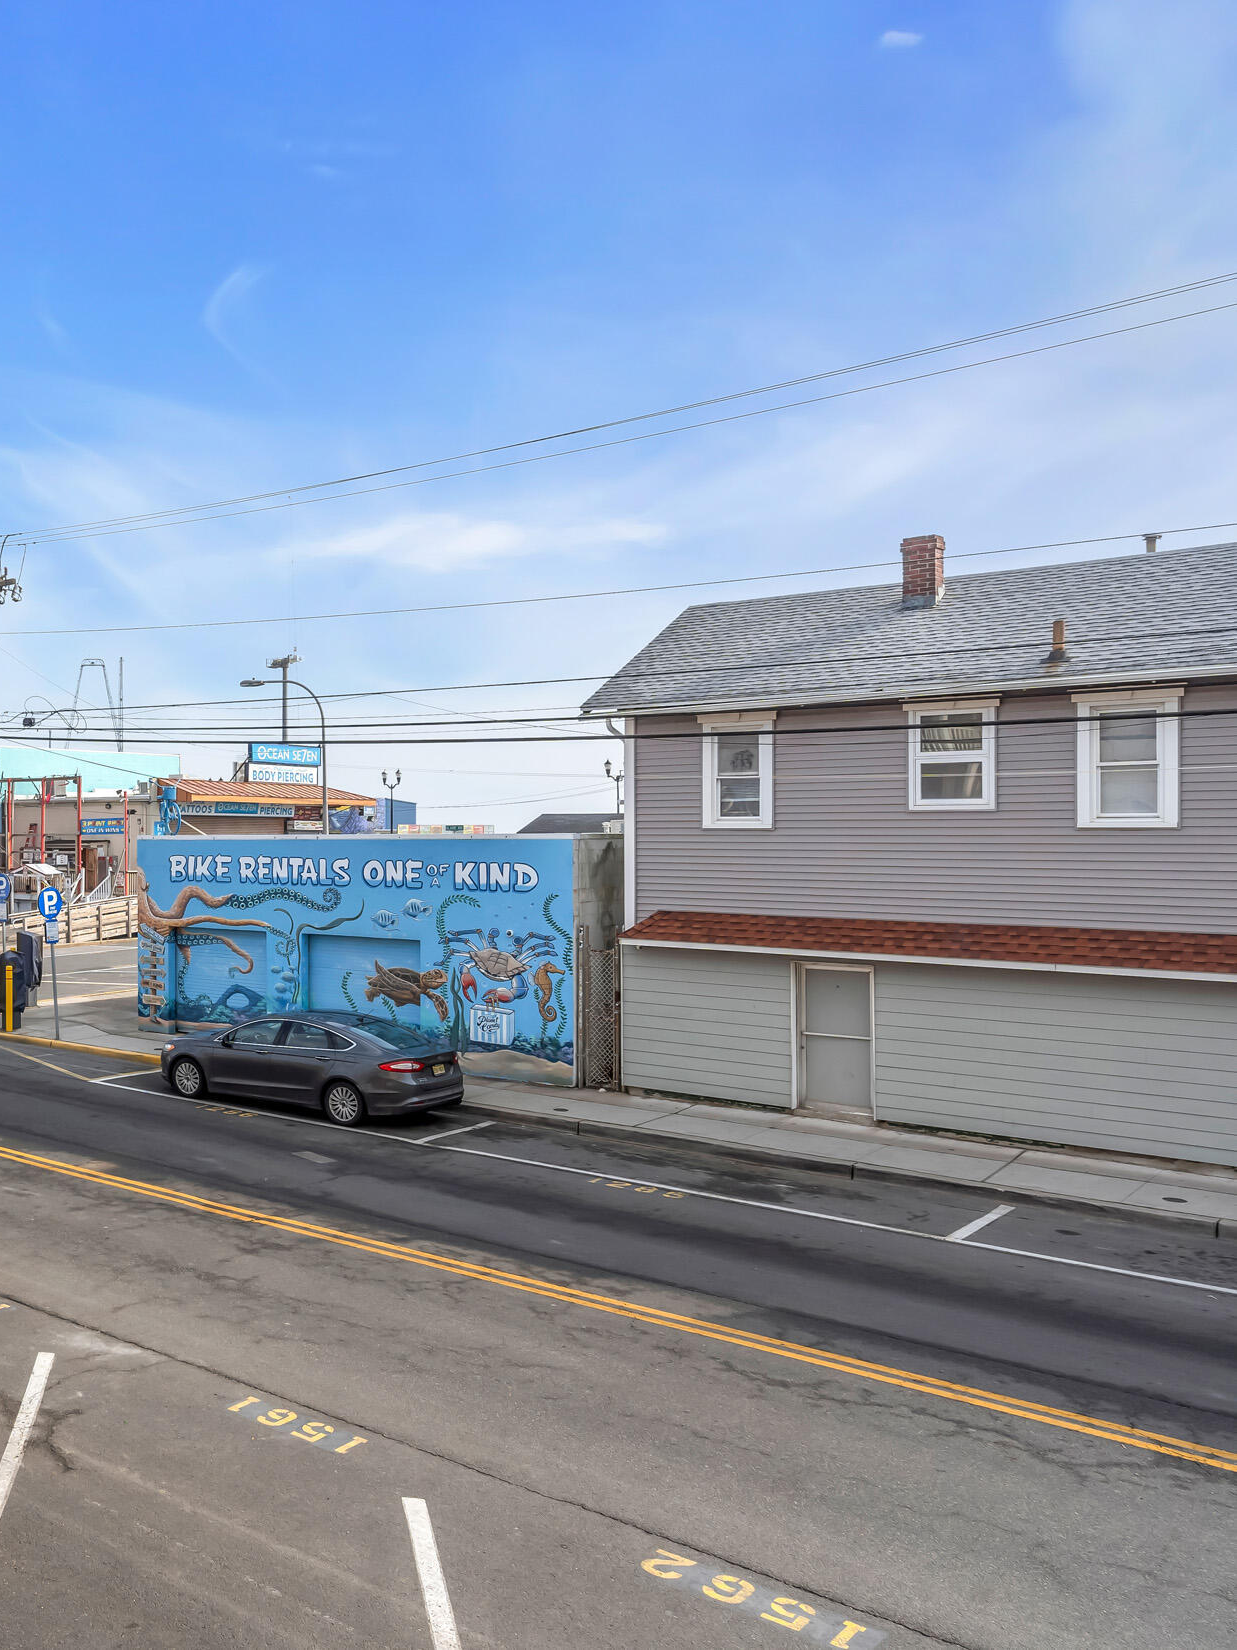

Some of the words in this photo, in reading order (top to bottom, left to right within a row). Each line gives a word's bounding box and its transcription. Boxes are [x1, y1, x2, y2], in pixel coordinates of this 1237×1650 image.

[257, 745, 290, 761] OCEAN
[252, 769, 277, 781] BODY
[277, 771, 314, 783] PIERCING
[259, 806, 293, 815] PIERCING
[169, 854, 233, 883] BIKE
[238, 855, 352, 887] RENTALS
[363, 859, 424, 889] ONE
[426, 864, 450, 876] OF
[454, 861, 540, 893] KIND
[431, 877, 441, 888] A
[43, 890, 58, 915] P
[227, 1396, 369, 1455] 1561
[640, 1548, 867, 1650] 1562
